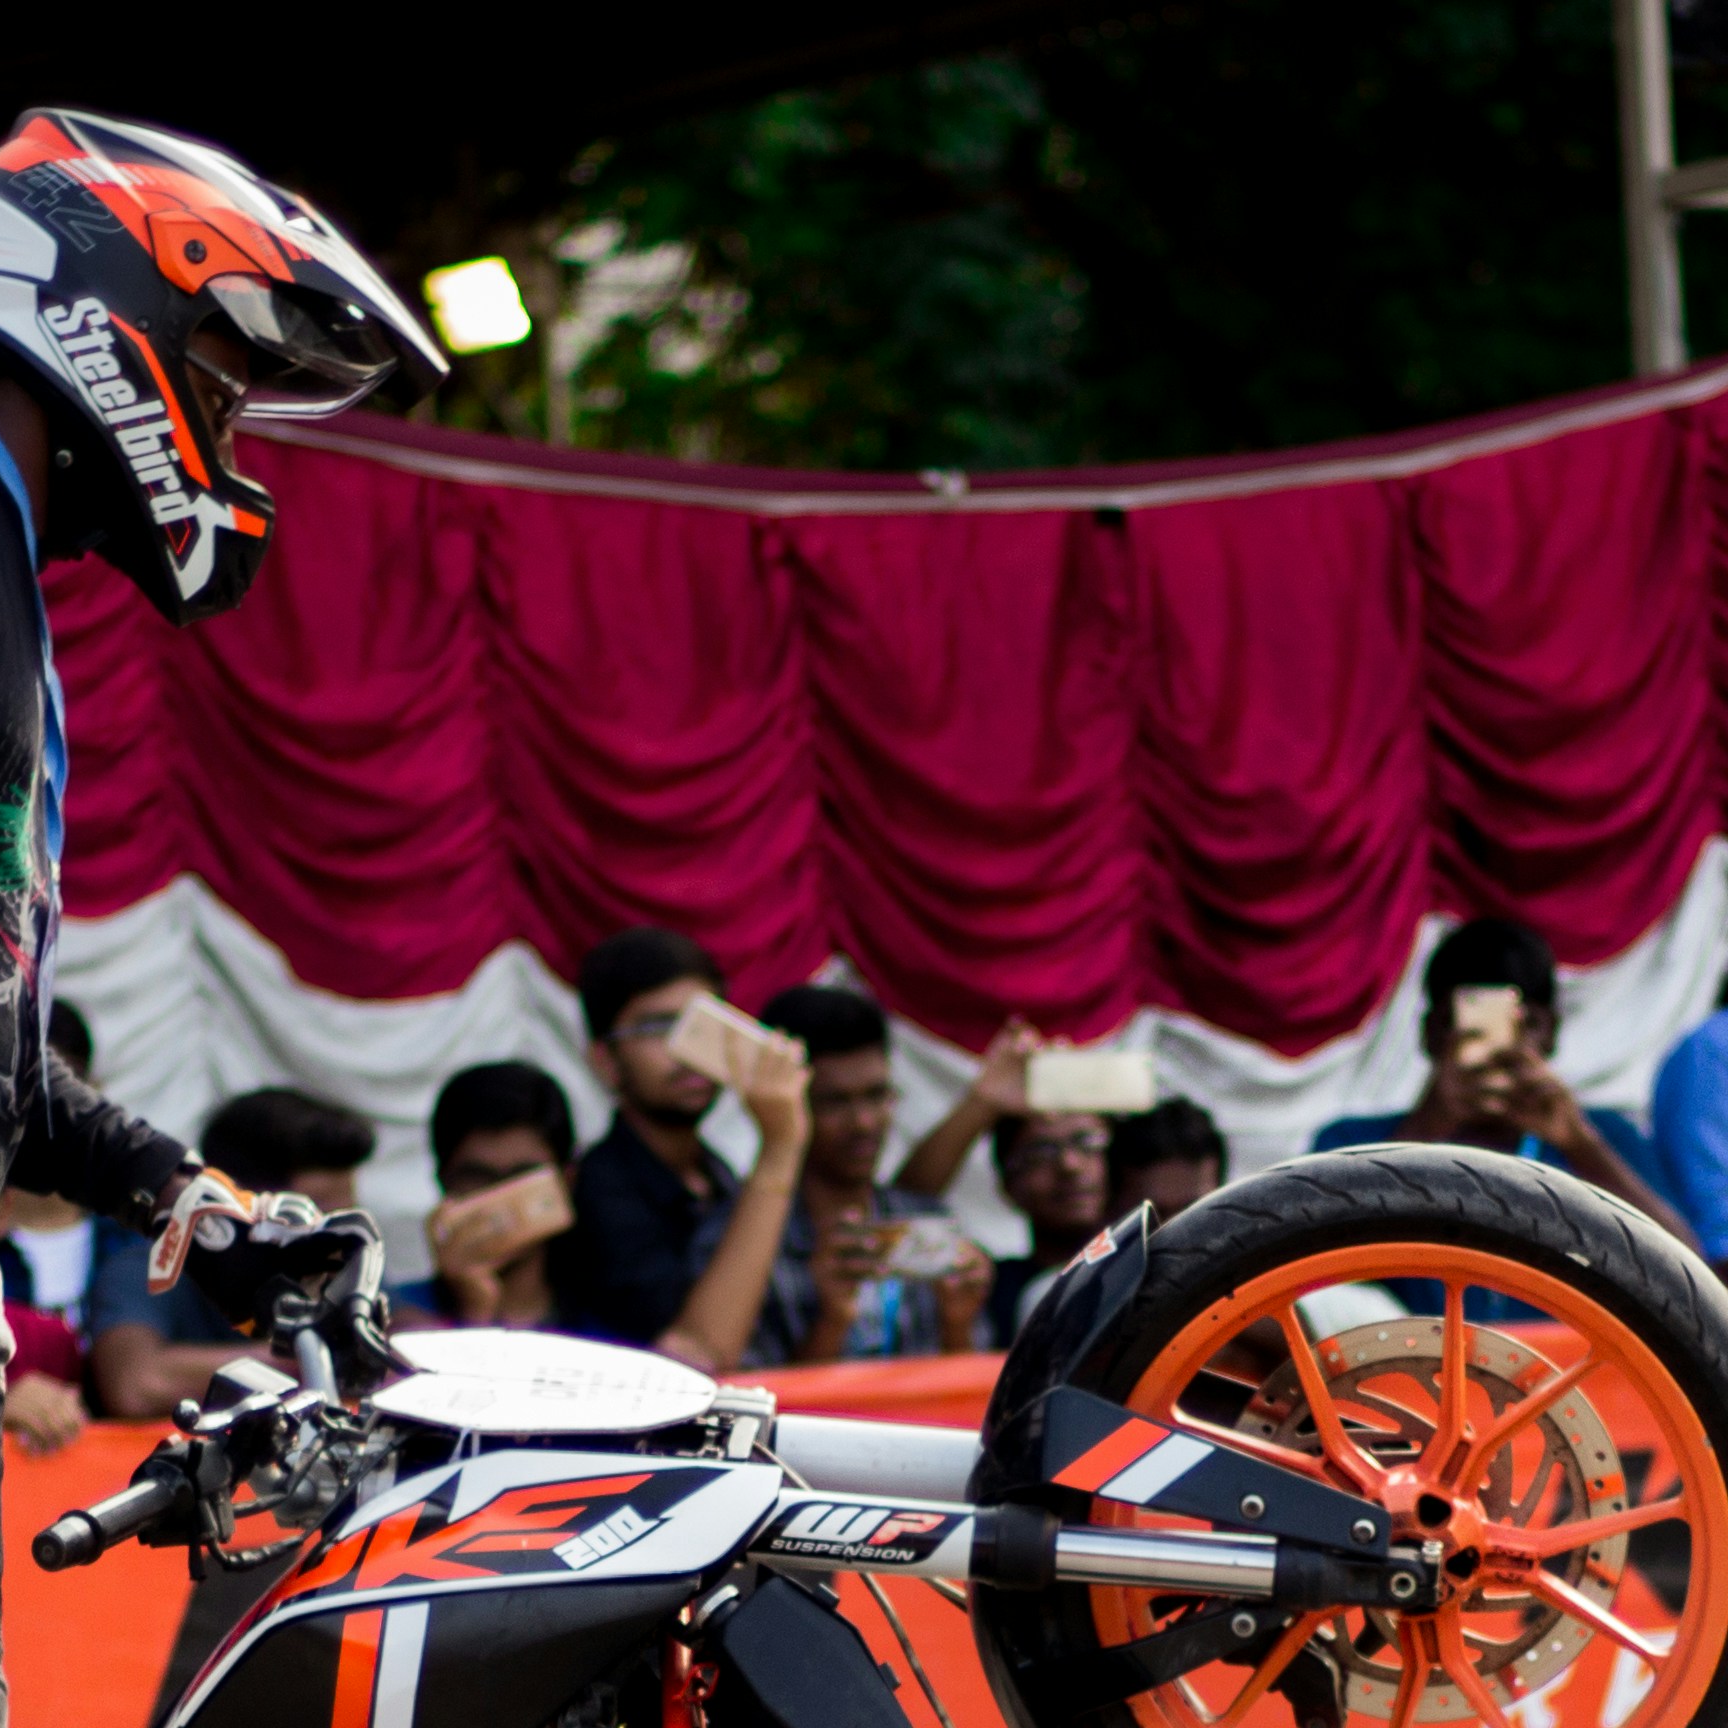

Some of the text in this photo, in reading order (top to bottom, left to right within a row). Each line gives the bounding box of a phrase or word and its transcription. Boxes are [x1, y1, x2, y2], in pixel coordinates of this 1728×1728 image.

[43, 296, 199, 526] Steelbird
[553, 1504, 661, 1570] 200
[770, 1540, 916, 1562] SUSPENSION
[781, 1504, 947, 1545] WP
